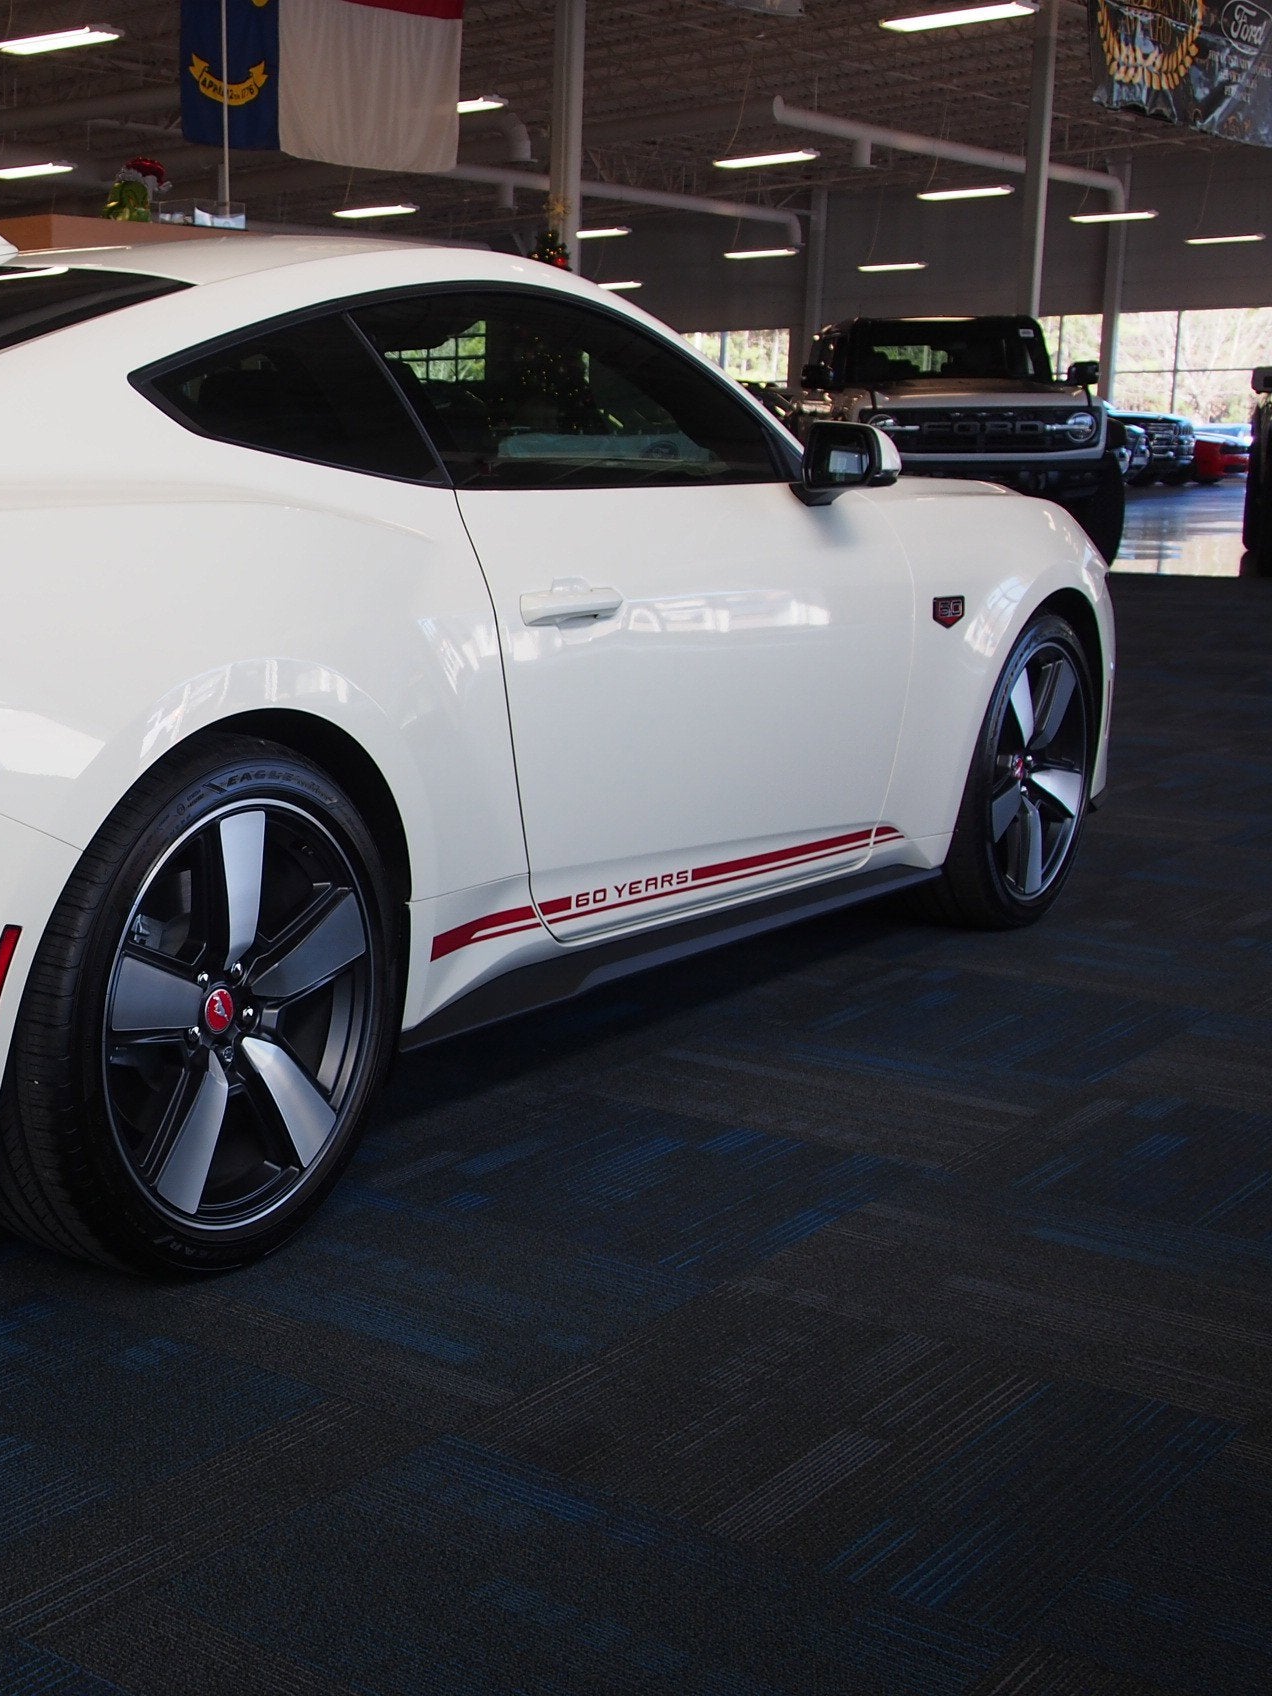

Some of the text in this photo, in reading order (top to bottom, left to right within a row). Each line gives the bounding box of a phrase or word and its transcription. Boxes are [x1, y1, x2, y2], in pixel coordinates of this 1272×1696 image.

[1230, 5, 1267, 45] Ford
[922, 420, 1045, 434] FORD
[226, 769, 295, 787] EAGLE
[575, 869, 689, 908] 60 YEARS
